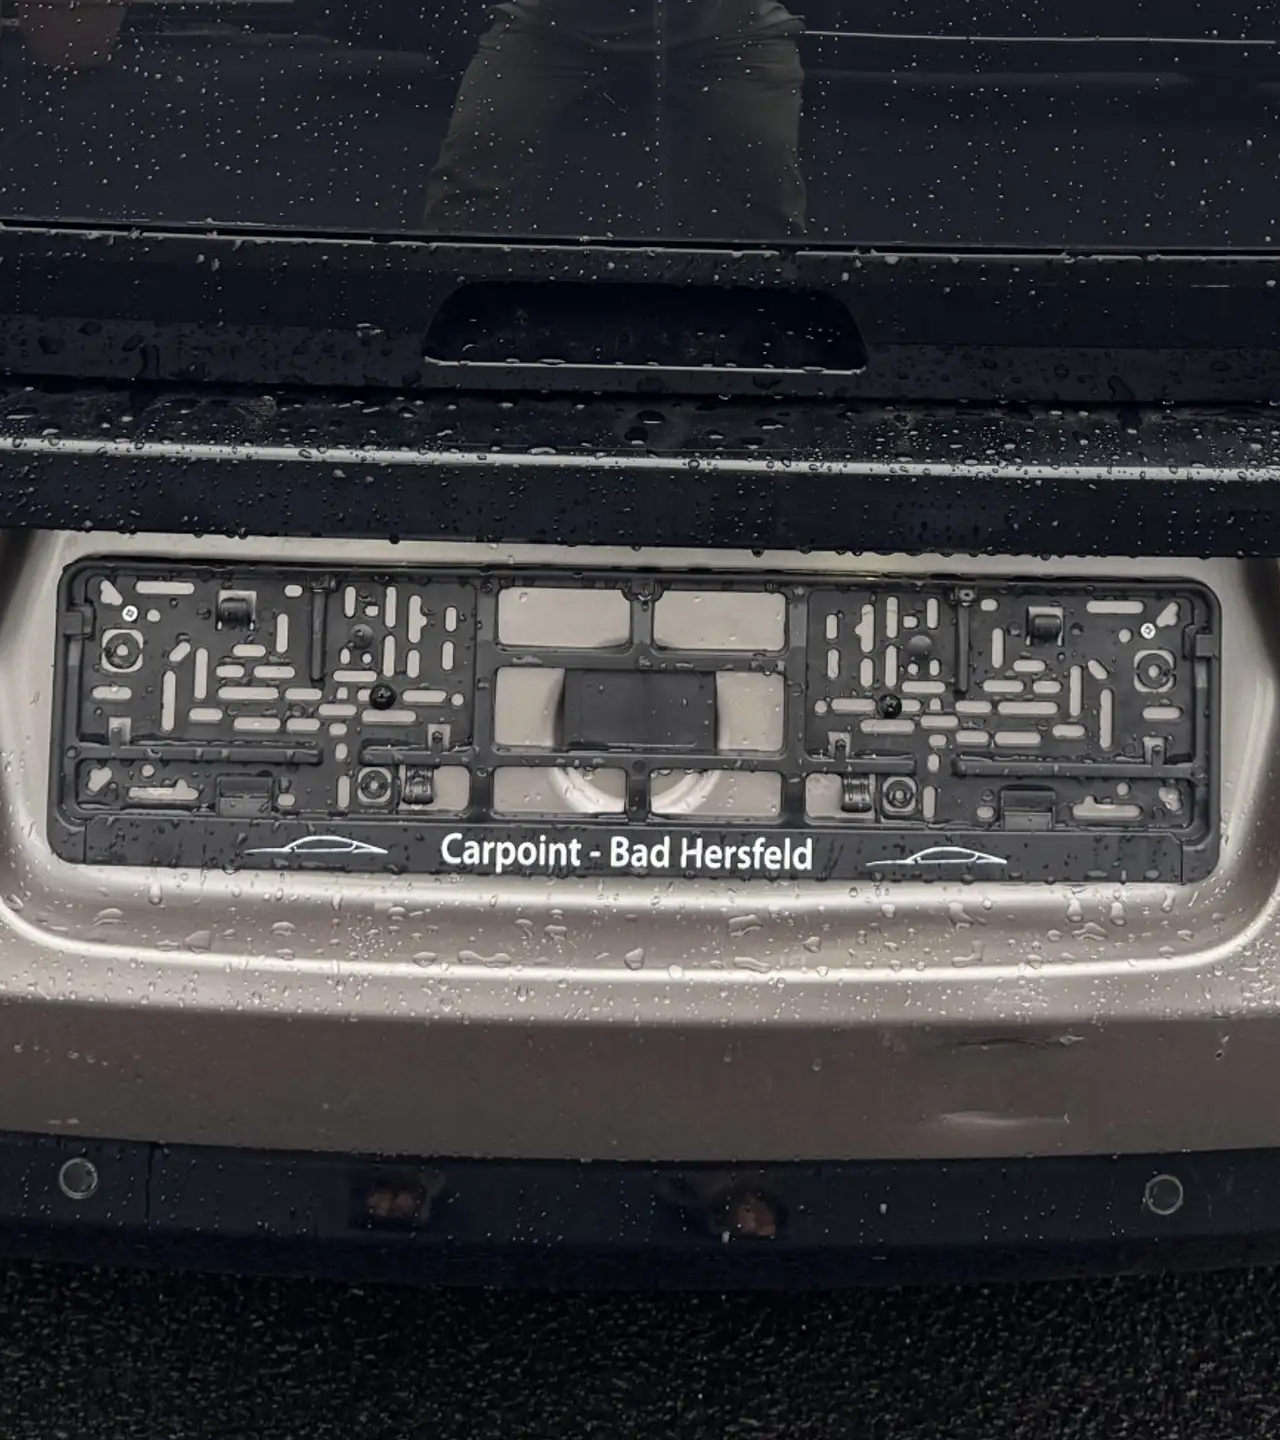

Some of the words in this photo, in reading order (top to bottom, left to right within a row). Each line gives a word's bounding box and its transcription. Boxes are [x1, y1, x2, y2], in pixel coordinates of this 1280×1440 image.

[440, 832, 582, 873] Carpoint
[610, 836, 670, 869] Bad
[680, 837, 814, 871] Hersfeld
